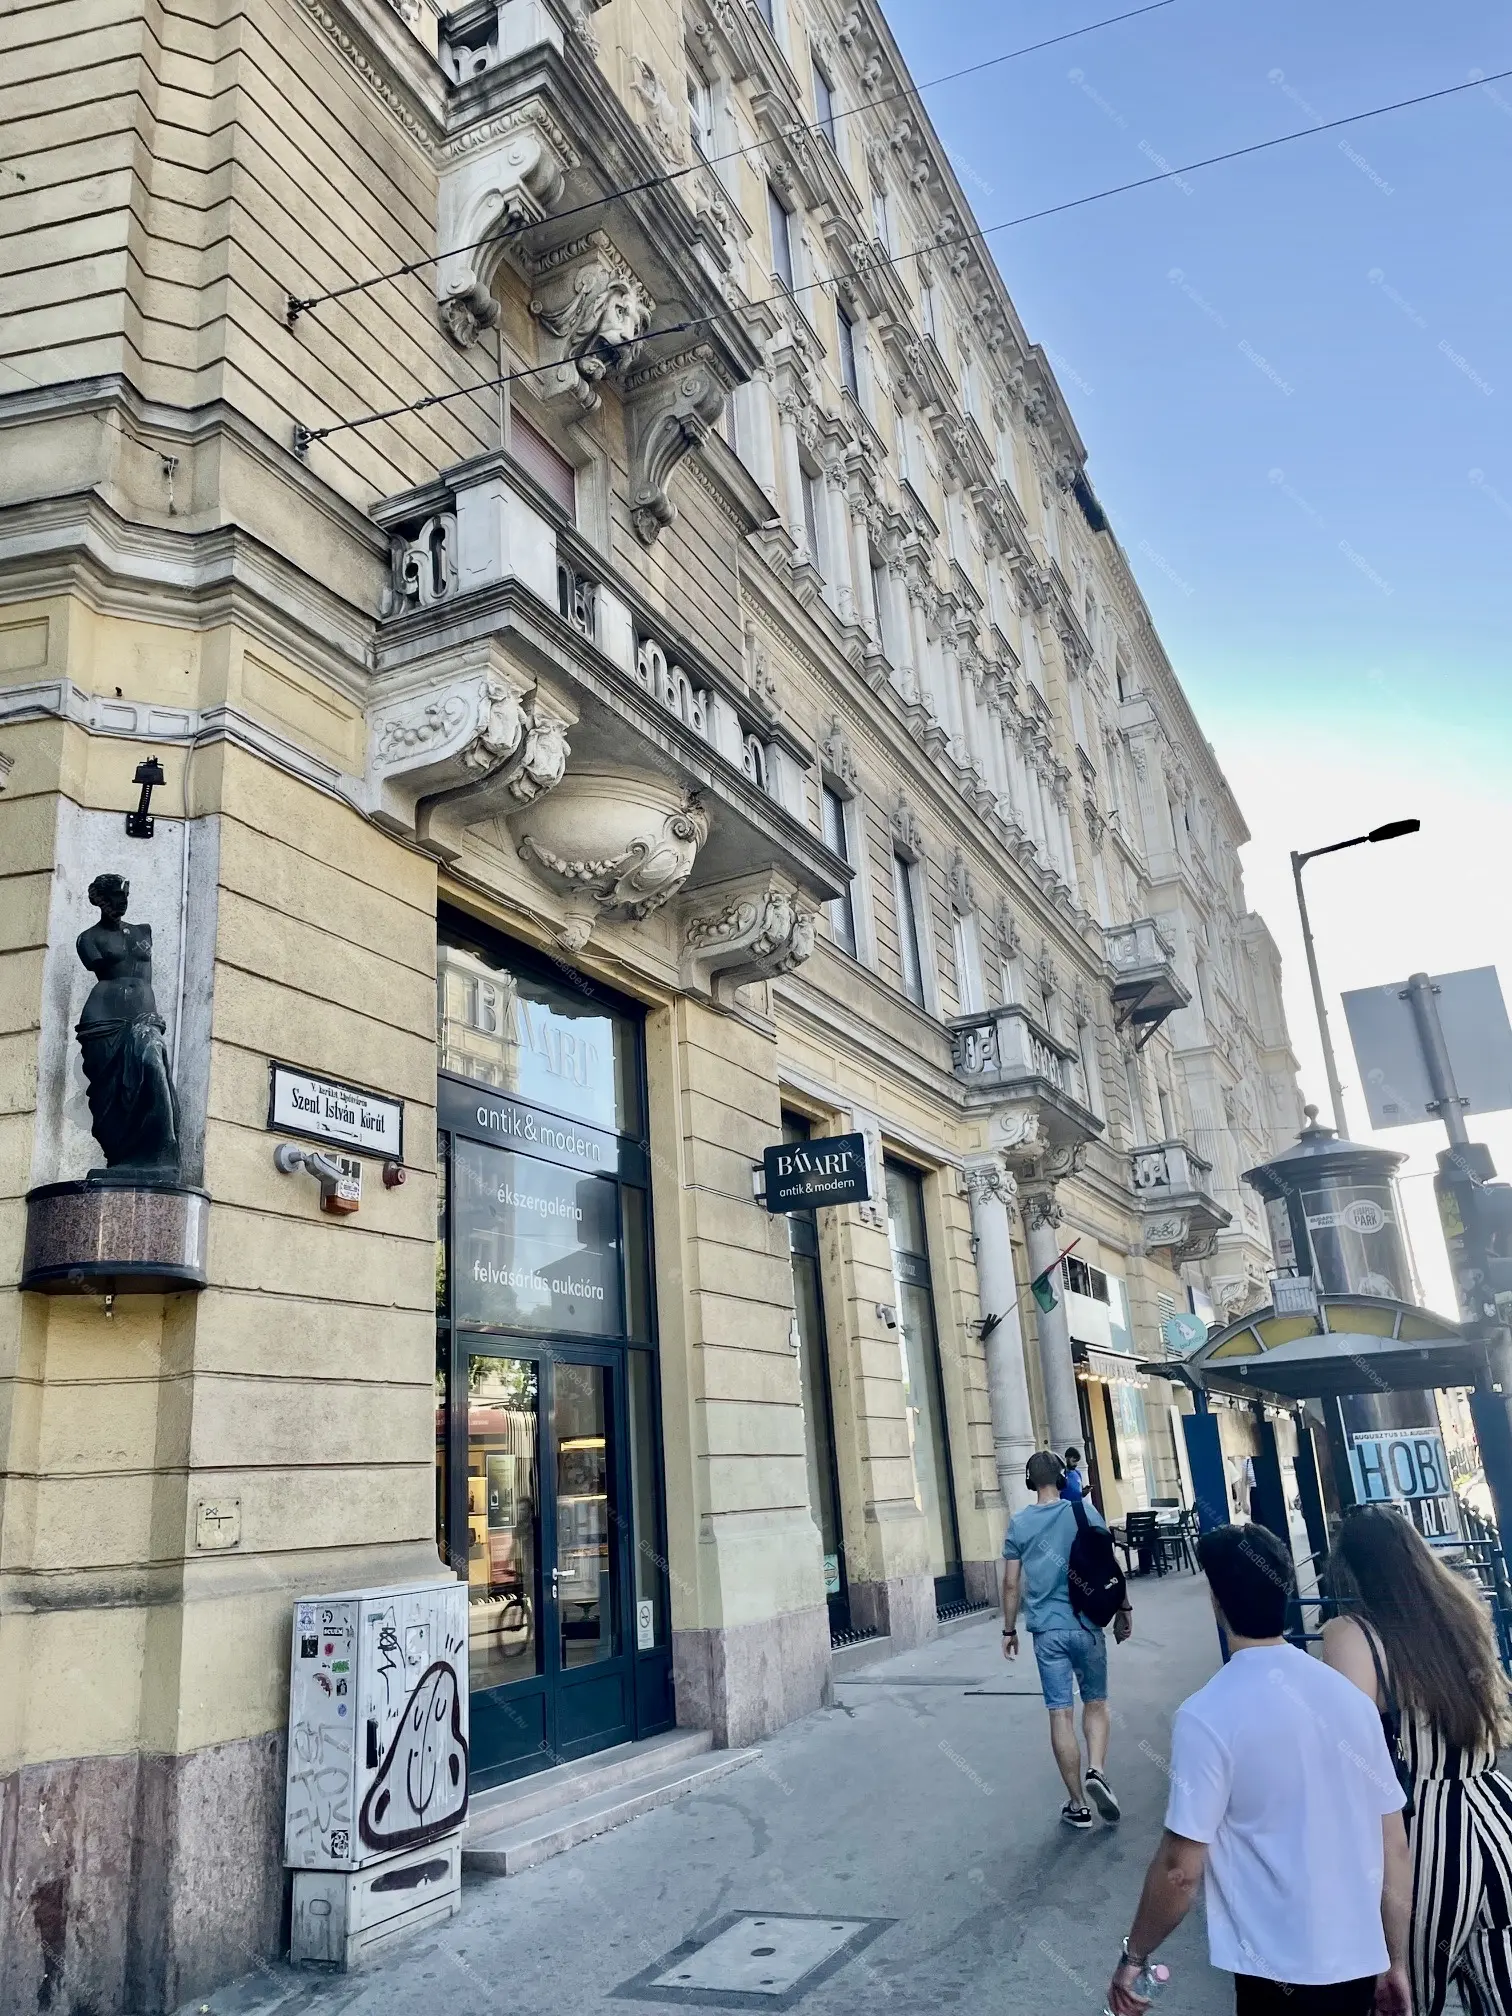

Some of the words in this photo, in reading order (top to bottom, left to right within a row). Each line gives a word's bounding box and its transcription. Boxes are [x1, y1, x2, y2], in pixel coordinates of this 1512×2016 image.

[292, 1087, 320, 1114] Szent
[325, 1097, 355, 1124] István
[360, 1108, 385, 1133] körút
[497, 1183, 583, 1222] ékszergaléria
[1354, 1214, 1378, 1226] PARK
[552, 1276, 604, 1300] aukcióra
[1354, 1431, 1399, 1440] AUGUSZTUS
